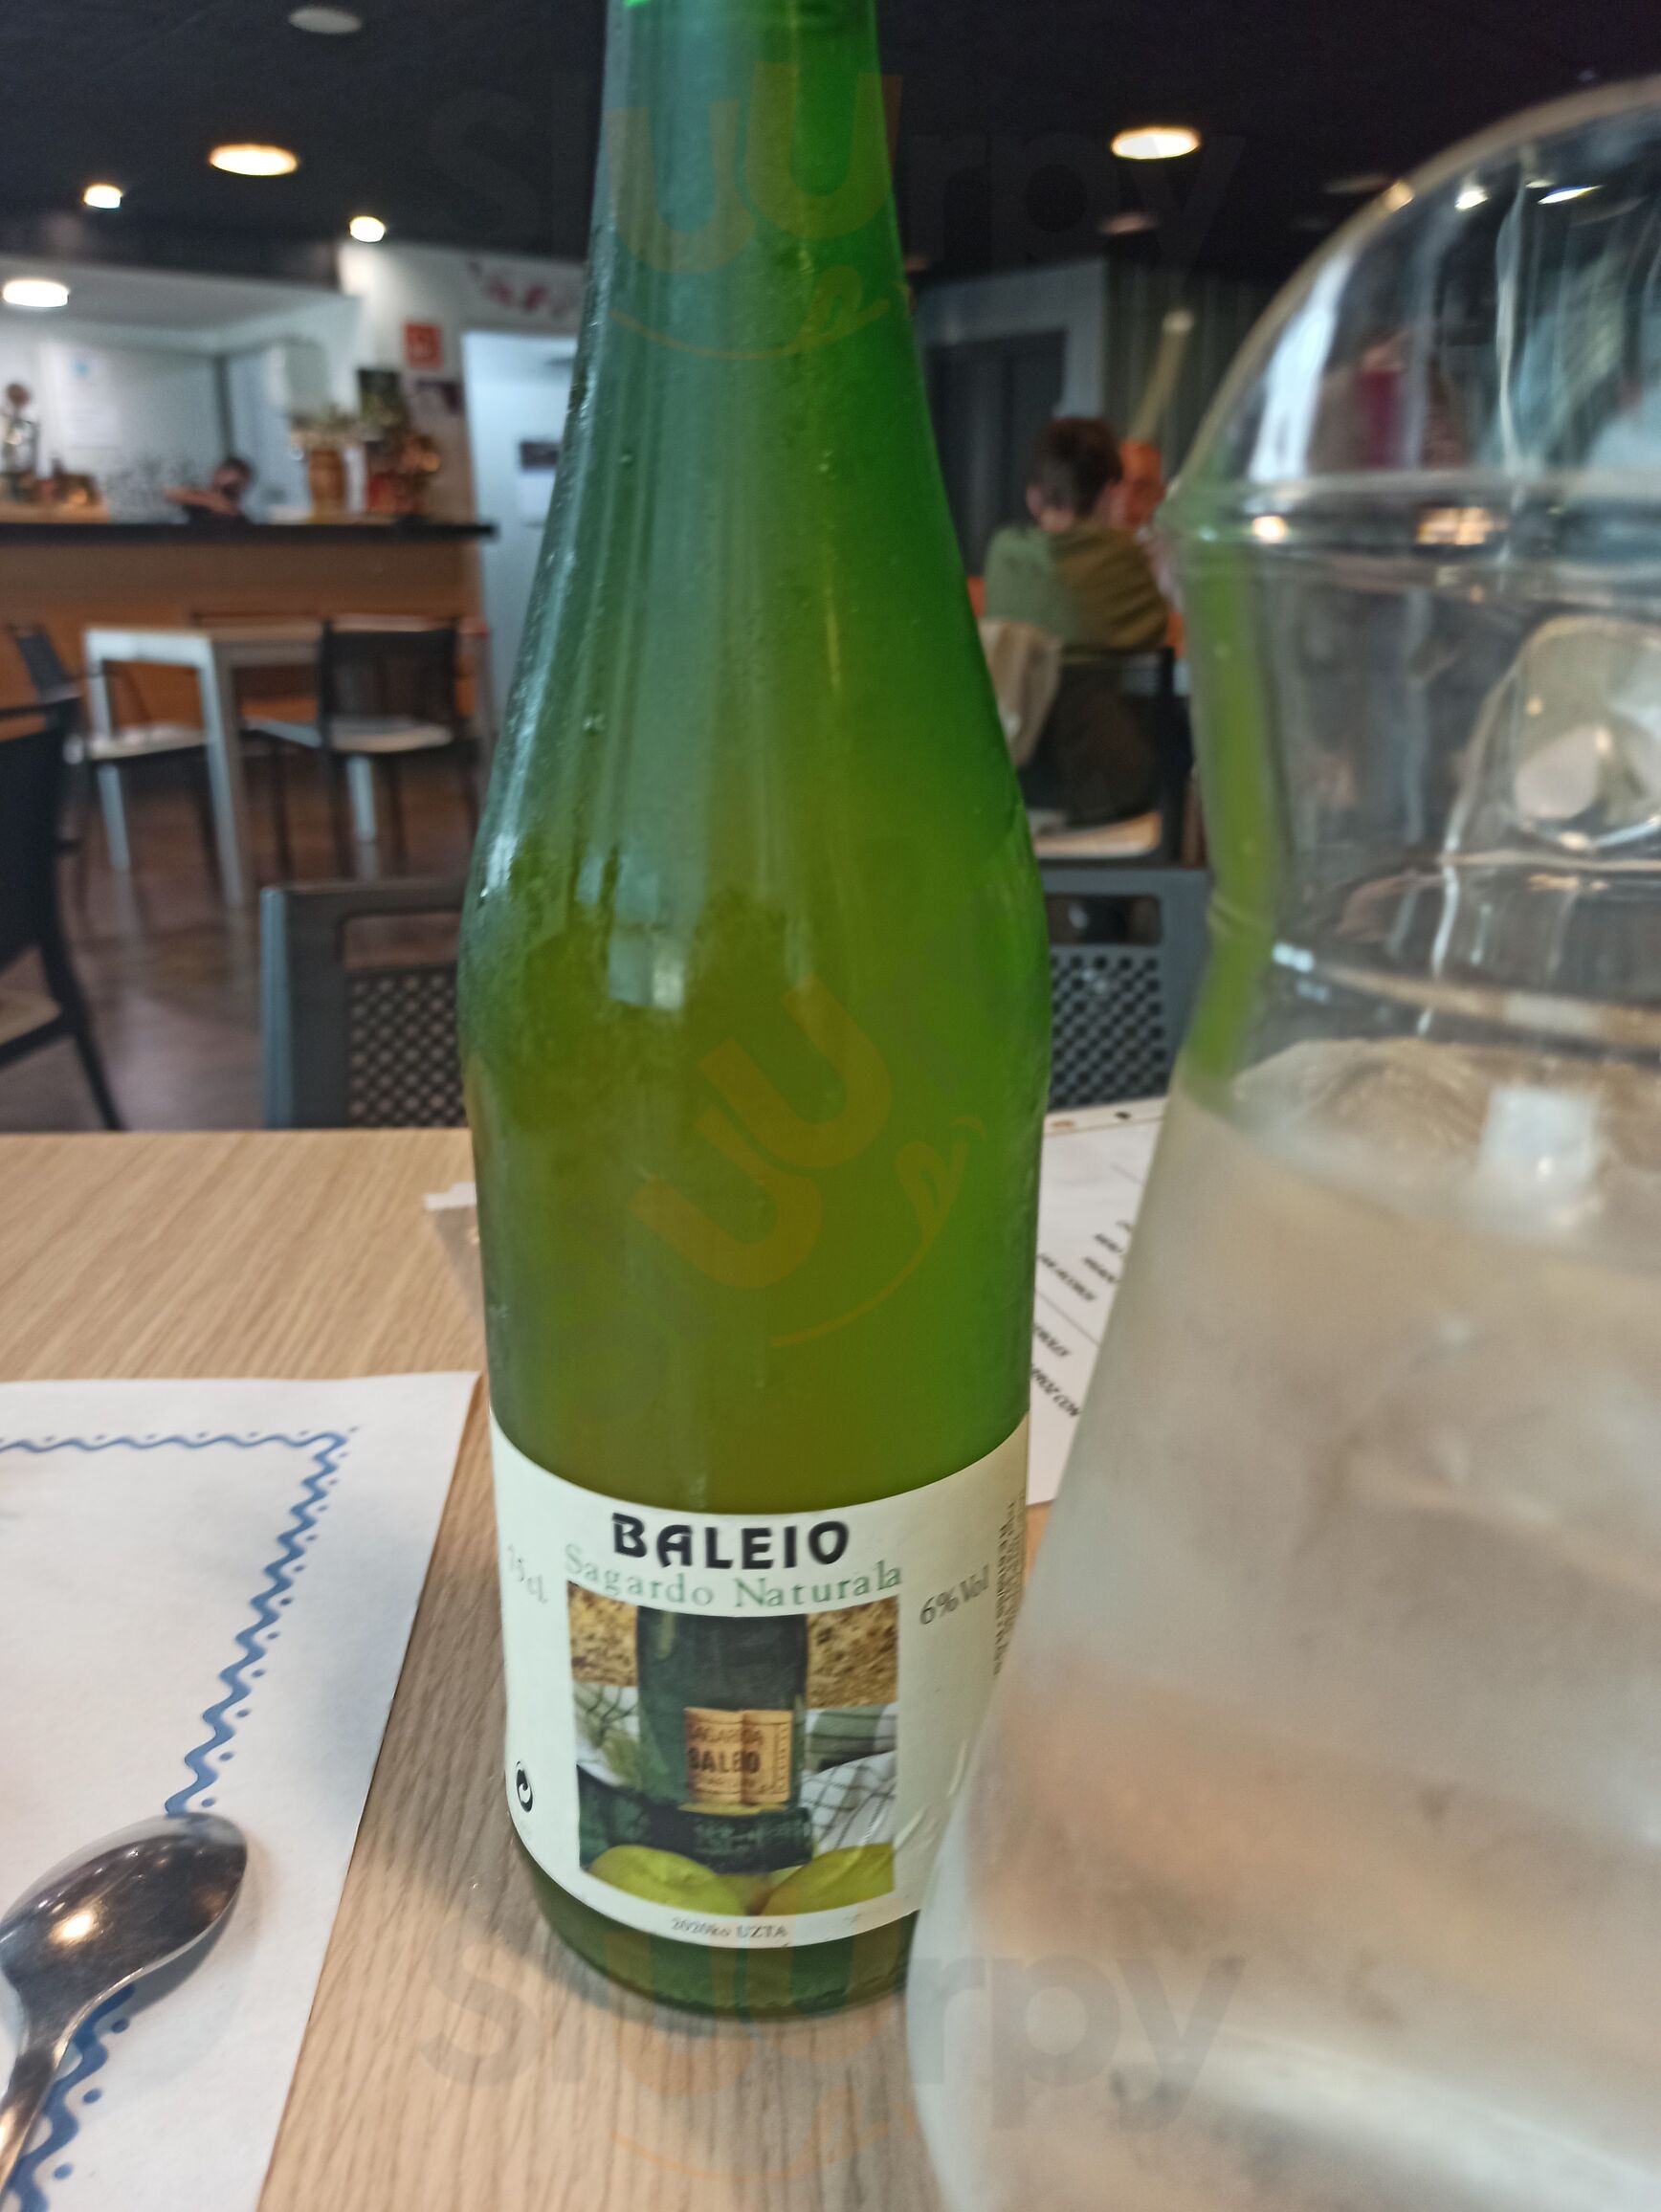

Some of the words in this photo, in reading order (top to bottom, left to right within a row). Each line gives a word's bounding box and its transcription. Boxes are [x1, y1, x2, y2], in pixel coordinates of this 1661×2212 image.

[611, 1512, 850, 1570] BALEIO
[565, 1541, 715, 1605] Sagardo
[734, 1559, 903, 1608] Naturala
[736, 1922, 787, 1939] UZTA
